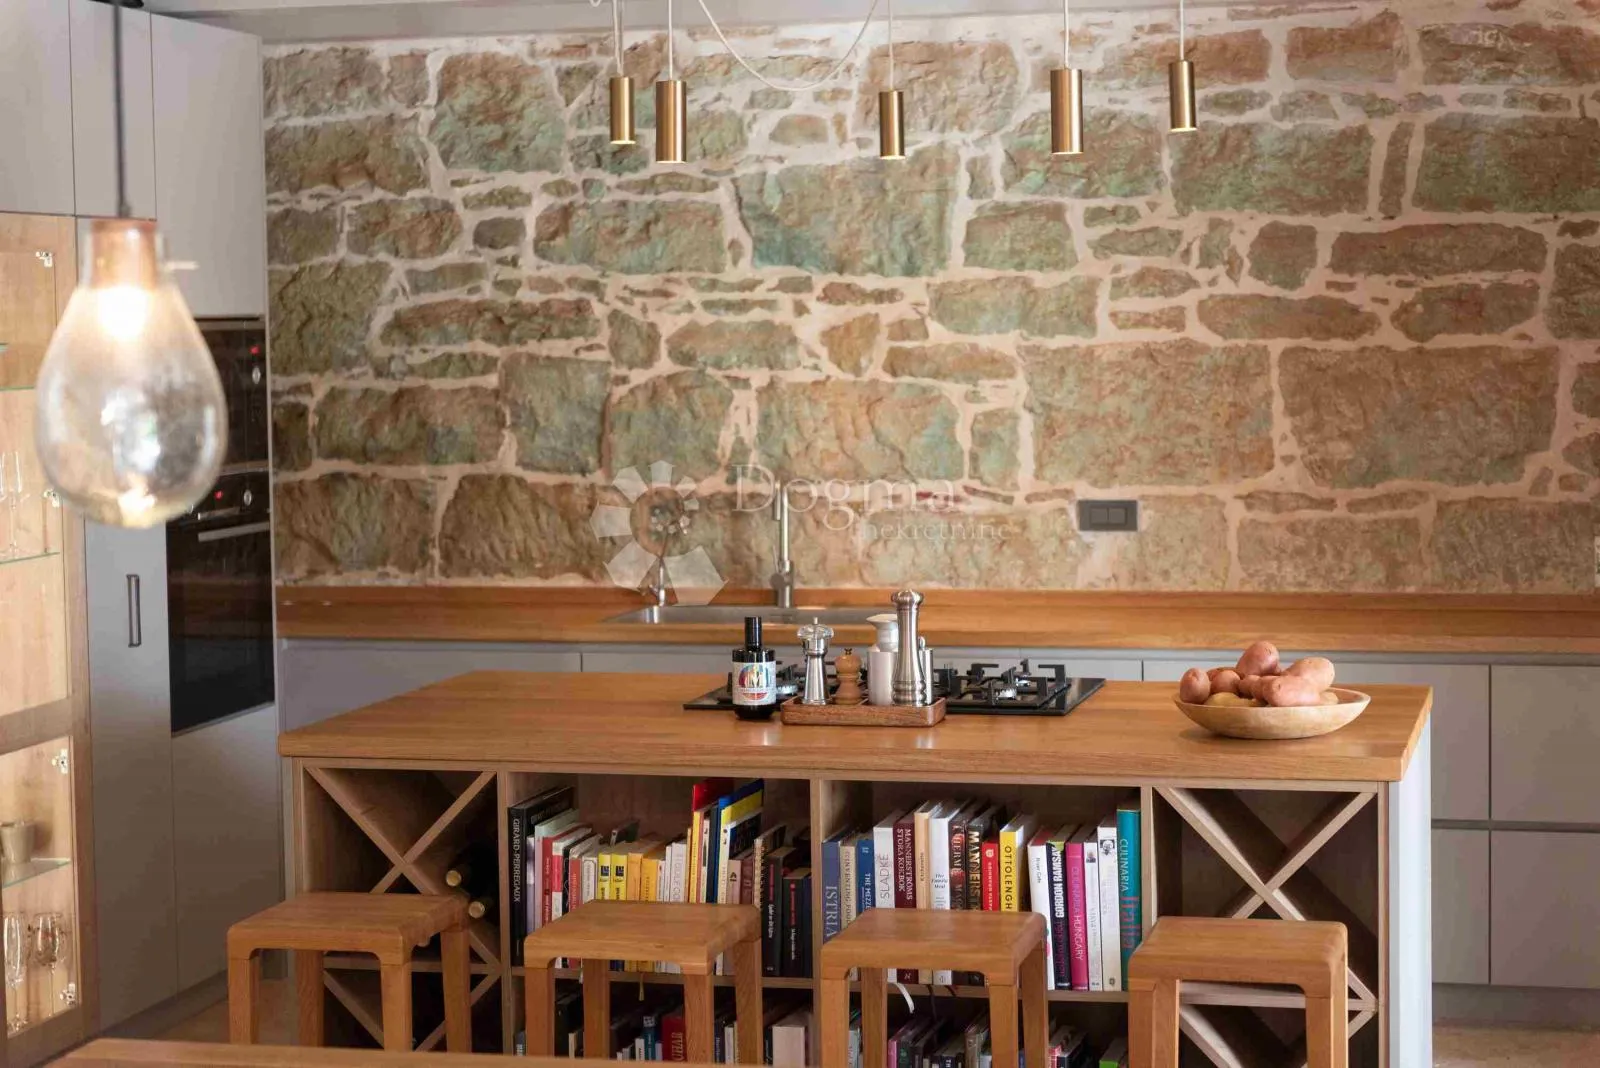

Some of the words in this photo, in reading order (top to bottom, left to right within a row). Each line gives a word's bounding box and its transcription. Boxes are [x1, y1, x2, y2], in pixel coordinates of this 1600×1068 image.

[512, 818, 521, 903] GIRARD-PERREGAUX
[897, 828, 905, 856] STORA
[905, 828, 913, 901] MANNERSTRÖMS
[1051, 846, 1063, 882] RAMSAY
[1119, 838, 1129, 892] CULINARIA
[898, 857, 906, 892] KOKBOK
[825, 885, 838, 937] ISTRIA
[1054, 882, 1065, 918] GORDON
[1120, 895, 1140, 949] Italia
[1073, 915, 1084, 961] HUNGARY
